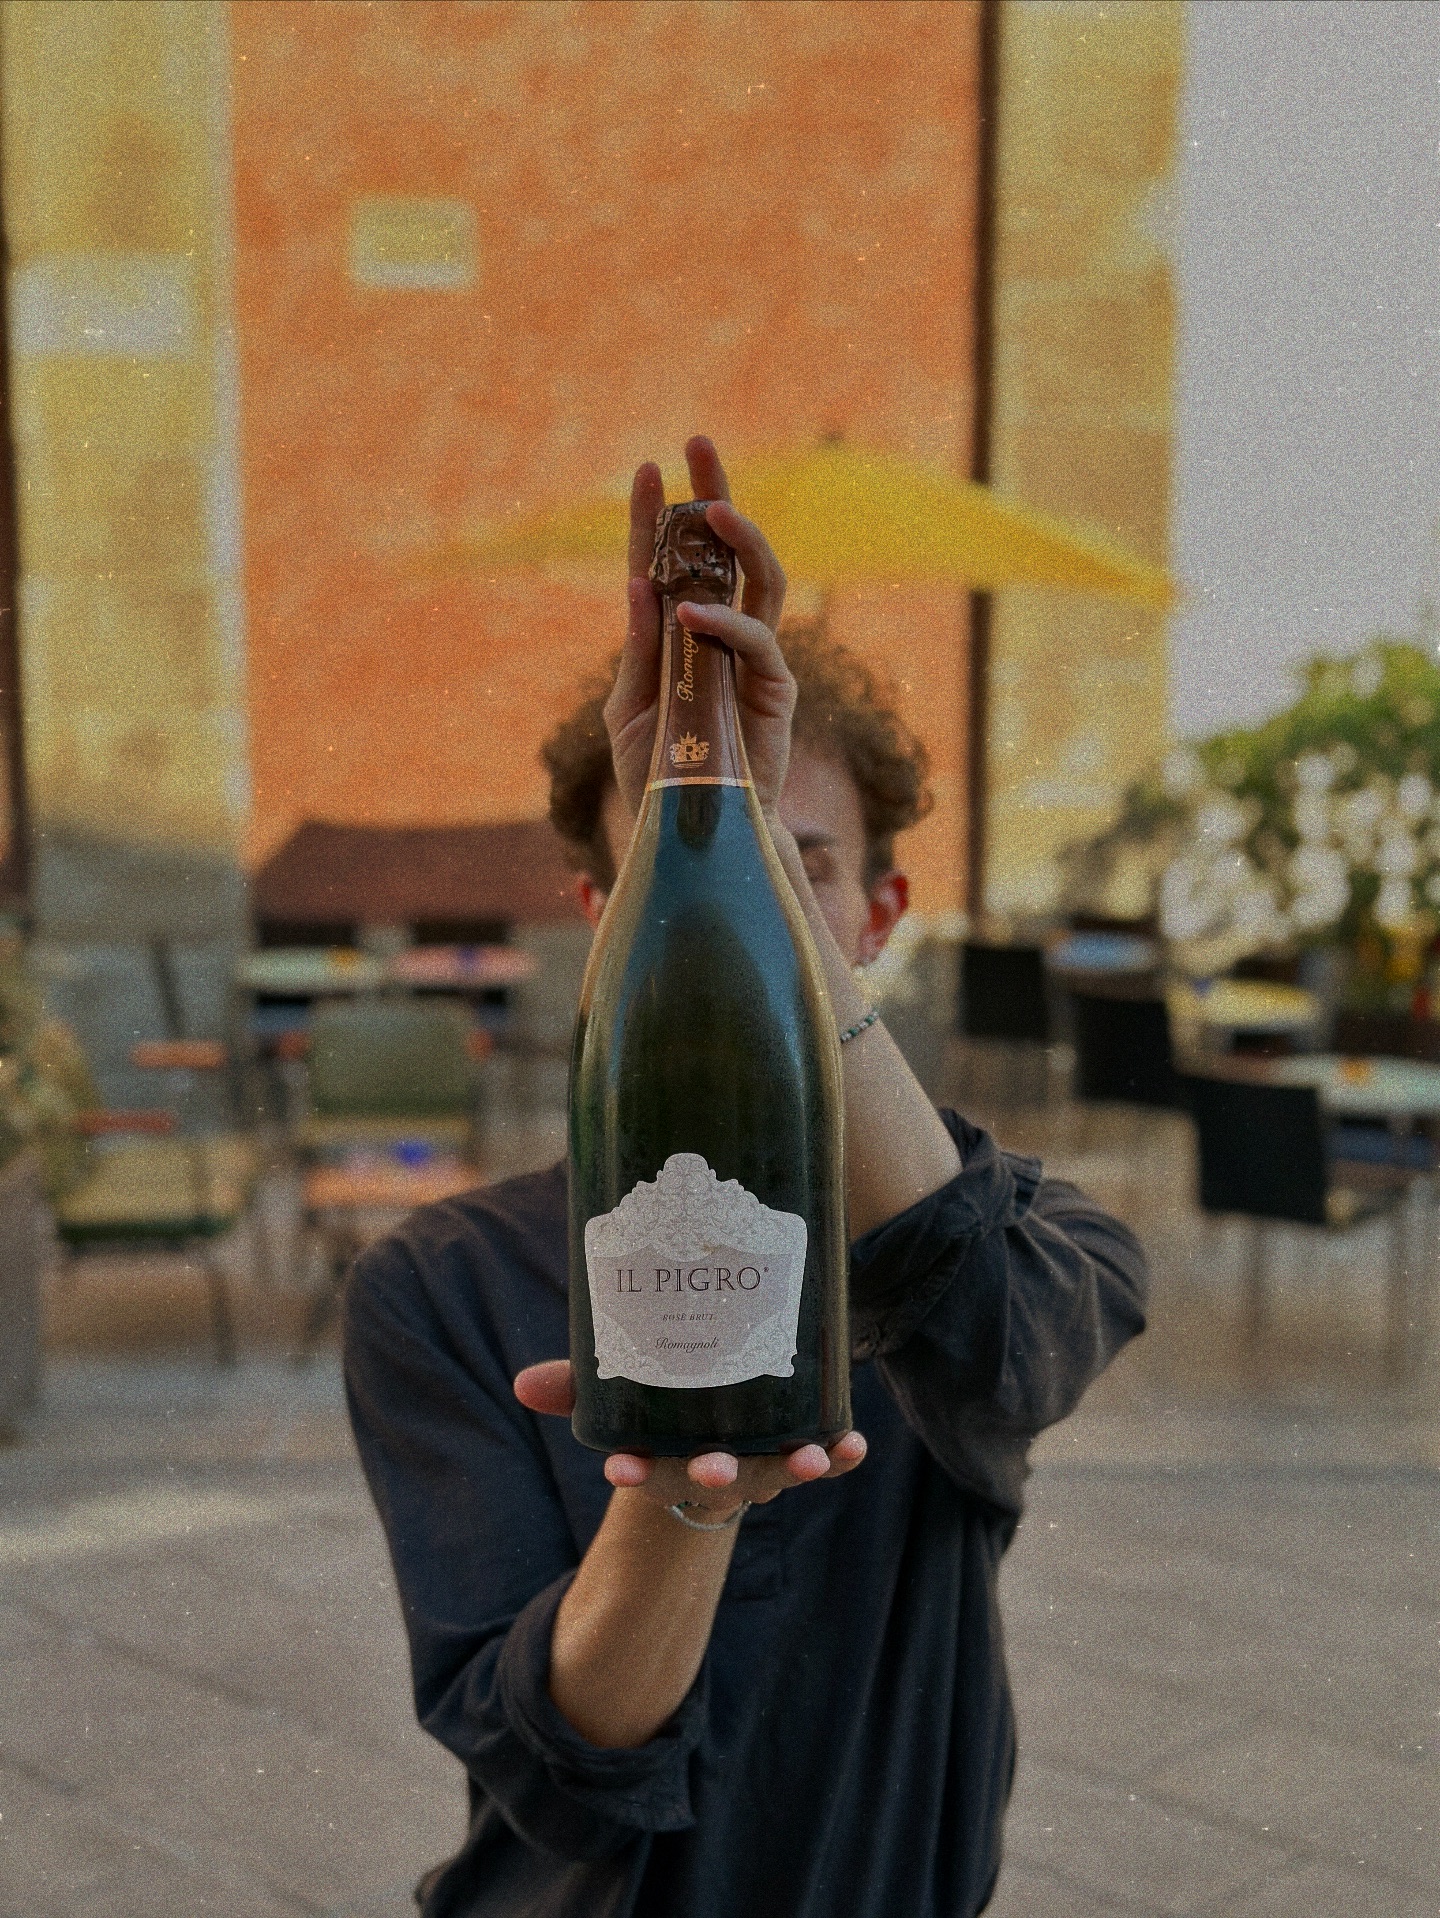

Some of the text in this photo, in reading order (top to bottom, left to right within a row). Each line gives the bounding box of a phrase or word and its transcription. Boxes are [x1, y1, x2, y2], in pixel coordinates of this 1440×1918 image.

[677, 626, 699, 701] Romagn
[616, 1269, 642, 1293] IL
[689, 1313, 714, 1321] BRUT
[655, 1336, 720, 1353] Romagnoli
